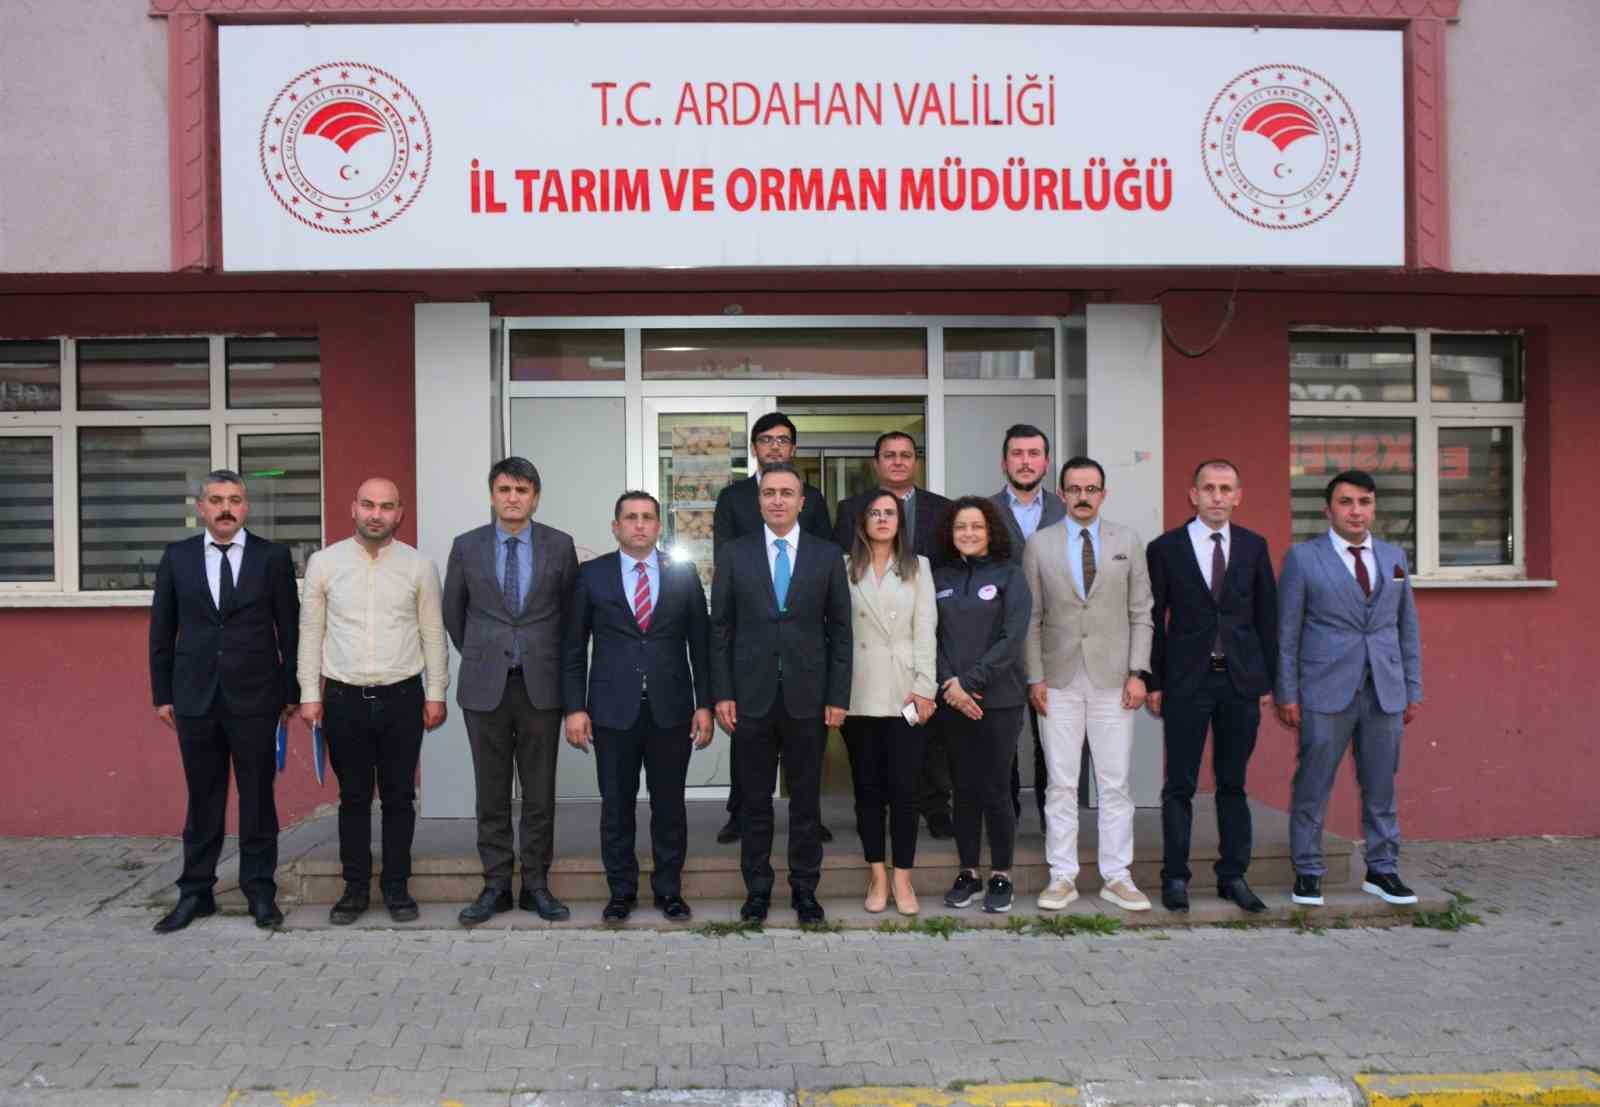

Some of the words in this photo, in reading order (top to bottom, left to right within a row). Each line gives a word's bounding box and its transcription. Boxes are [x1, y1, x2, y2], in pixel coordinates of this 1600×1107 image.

[592, 82, 662, 127] T.C.
[676, 81, 883, 127] ARDAHAN
[894, 74, 1057, 127] VALİLİĞİ
[470, 159, 508, 215] İL
[514, 167, 651, 214] TARIM
[659, 167, 715, 213] VE
[724, 167, 888, 213] ORMAN
[899, 156, 1174, 213] MÜDÜRLÜĞÜ
